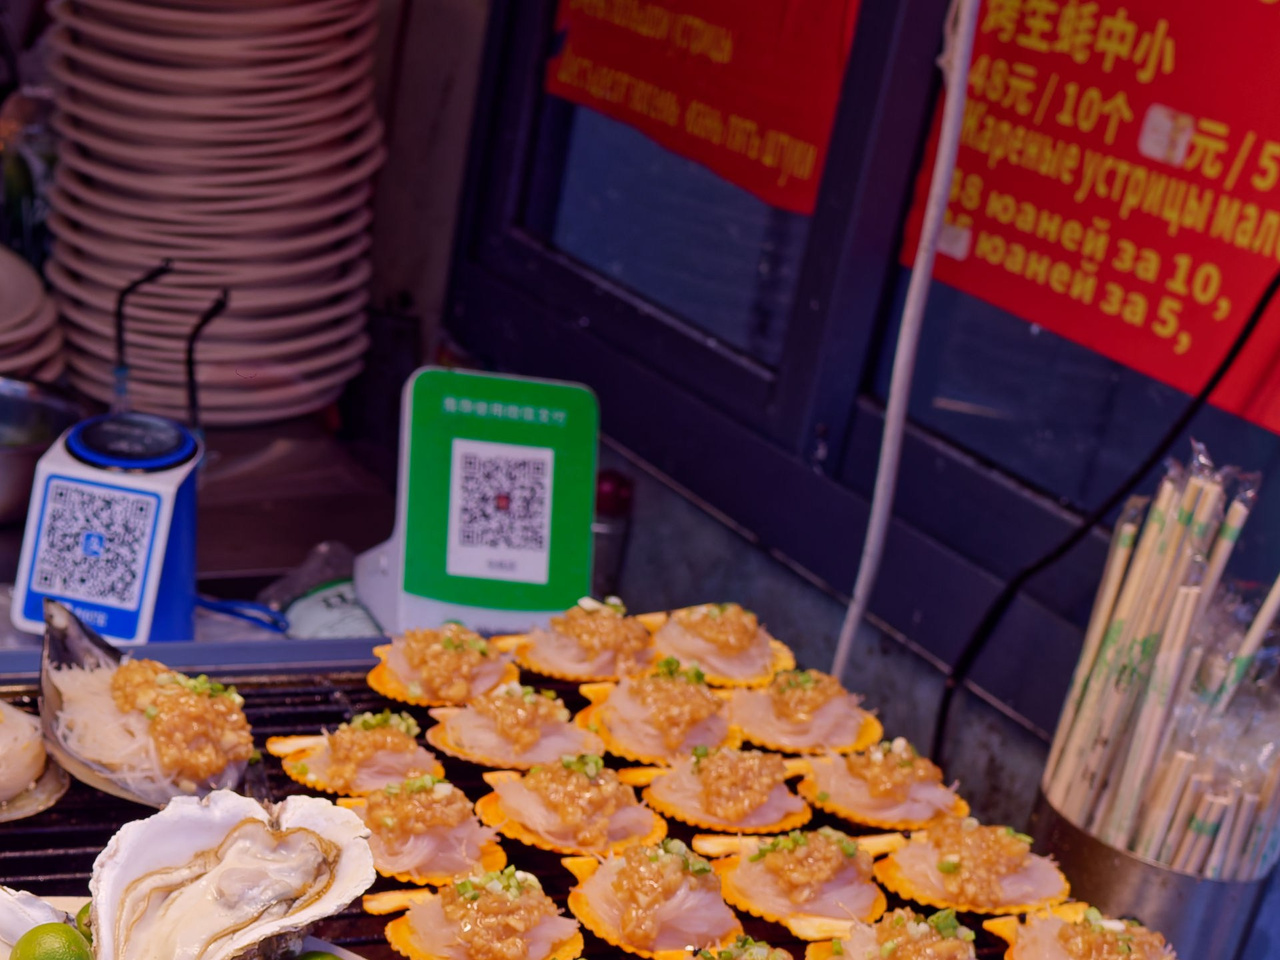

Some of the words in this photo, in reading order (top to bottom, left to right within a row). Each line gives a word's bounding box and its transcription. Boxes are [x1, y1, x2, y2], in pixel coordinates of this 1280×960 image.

[985, 190, 1111, 264] юаней
[1111, 238, 1162, 284] за
[1164, 253, 1232, 322] 10,
[1073, 148, 1215, 238] устрицы
[1210, 194, 1280, 262] мал
[974, 230, 1100, 306] юаней
[1099, 281, 1150, 329] за
